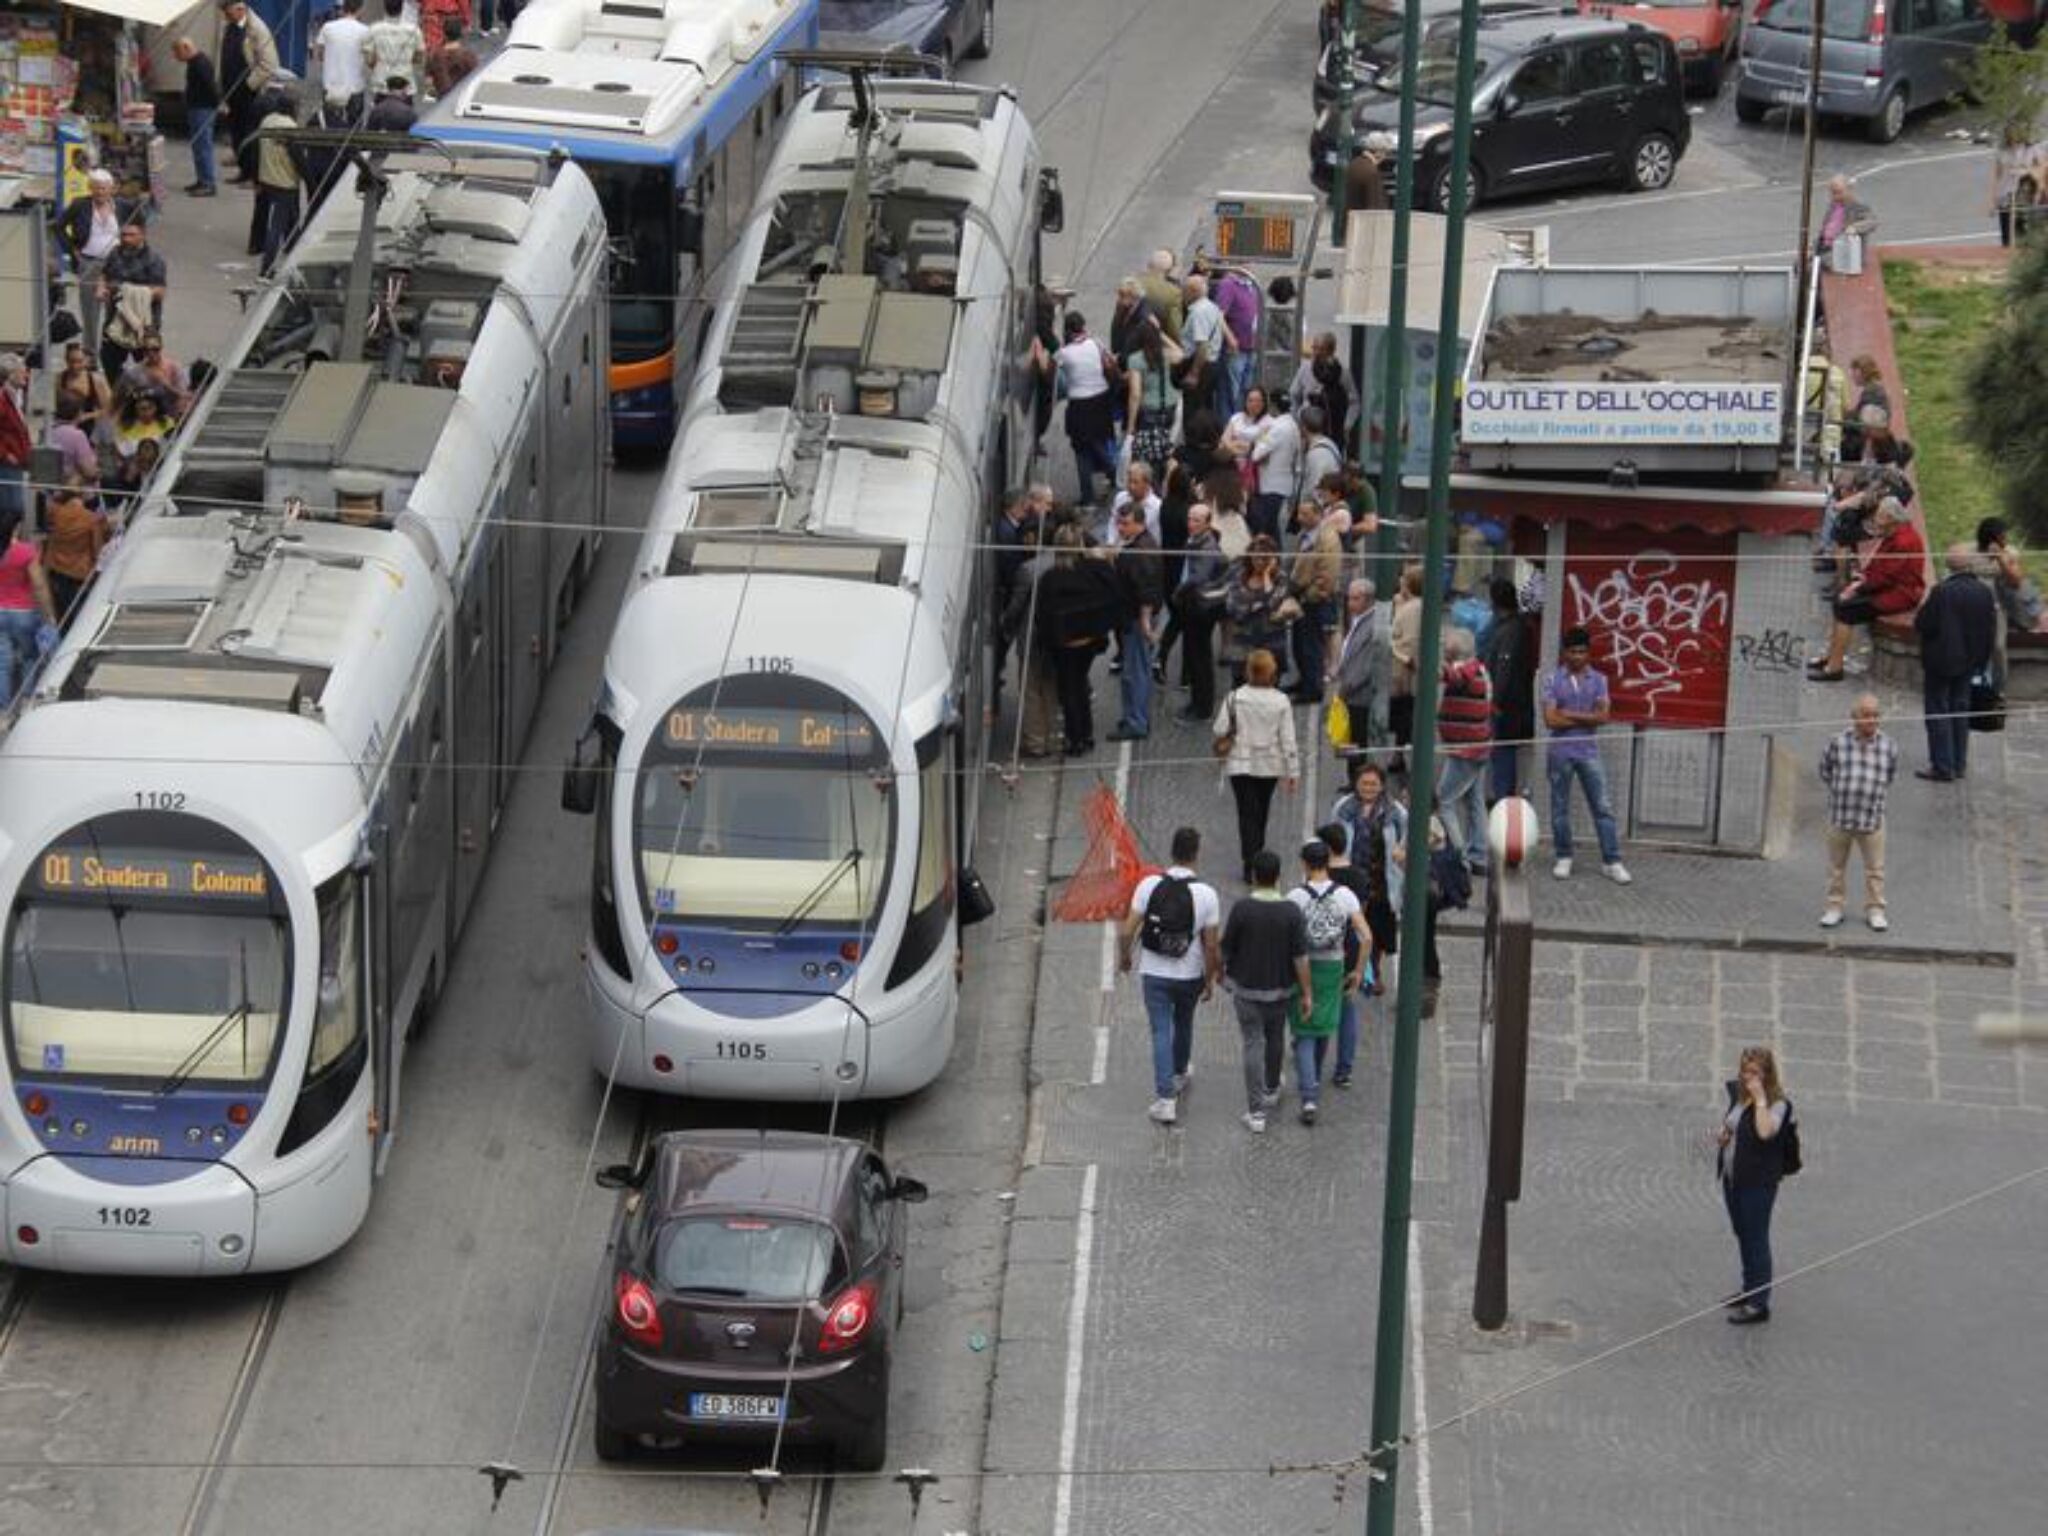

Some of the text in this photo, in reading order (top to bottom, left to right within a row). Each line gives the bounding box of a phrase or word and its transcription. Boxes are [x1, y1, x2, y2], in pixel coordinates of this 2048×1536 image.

[1467, 390, 1777, 411] OUTLET DELL'OCCHIALE
[746, 656, 794, 675] 1105
[134, 792, 186, 810] 1102
[45, 855, 72, 885] 01
[716, 1041, 767, 1060] 1105
[98, 1207, 152, 1227] 1102
